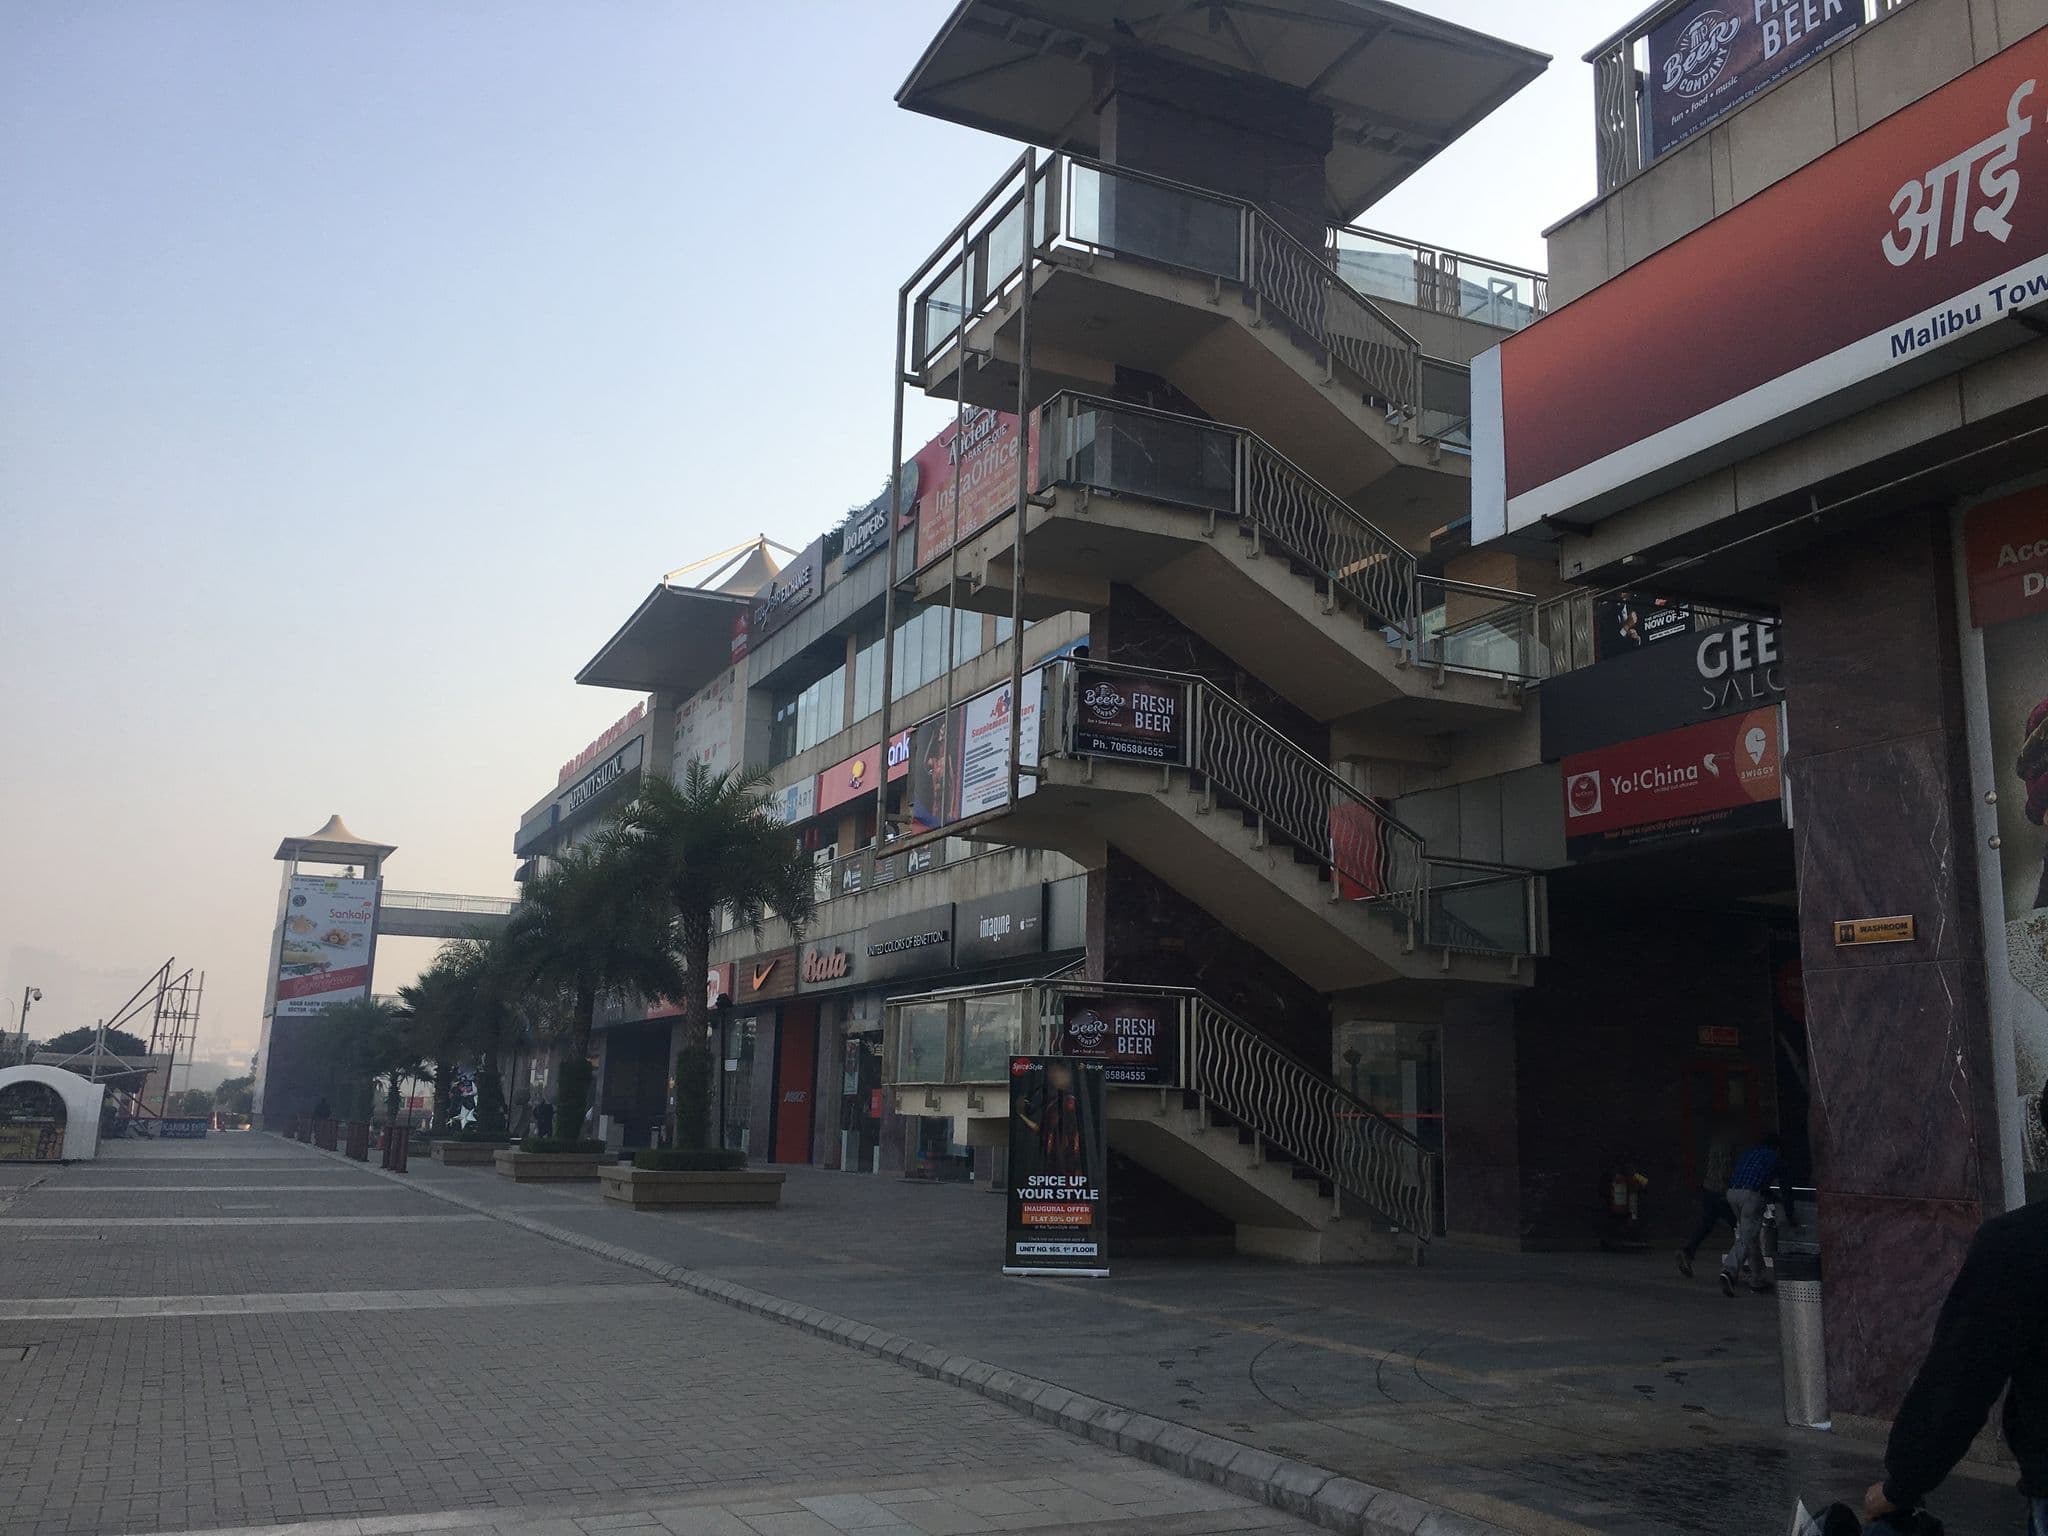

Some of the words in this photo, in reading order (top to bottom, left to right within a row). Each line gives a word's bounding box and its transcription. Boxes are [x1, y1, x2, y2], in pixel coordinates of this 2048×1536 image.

[1761, 0, 1843, 60] BEER
[1662, 16, 1741, 93] Beer
[1679, 47, 1728, 92] COMPANY
[1671, 112, 1684, 126] fun
[1691, 93, 1708, 113] food
[1715, 75, 1738, 96] music
[1890, 304, 1982, 358] Malibu
[1084, 689, 1126, 706] Beer
[1132, 692, 1175, 716] FRESH
[1092, 704, 1119, 718] COMPANY
[1135, 712, 1171, 733] BEER
[888, 731, 910, 767] ank
[1092, 739, 1109, 749] Ph.
[1111, 741, 1164, 757] 7065884555
[1610, 764, 1698, 795] Yo!China
[1741, 765, 1775, 779] SWIGGY
[329, 908, 371, 922] Sankalp
[1860, 922, 1908, 933] WASHROOM
[802, 950, 848, 984] Bata
[1115, 1017, 1155, 1036] FRESH
[1118, 1036, 1152, 1055] BEER
[1028, 1175, 1066, 1186] SPICE
[1069, 1175, 1087, 1187] UP
[1017, 1188, 1053, 1200] YOUR
[1056, 1188, 1099, 1200] STYLE
[1024, 1205, 1065, 1213] INAUGURAL
